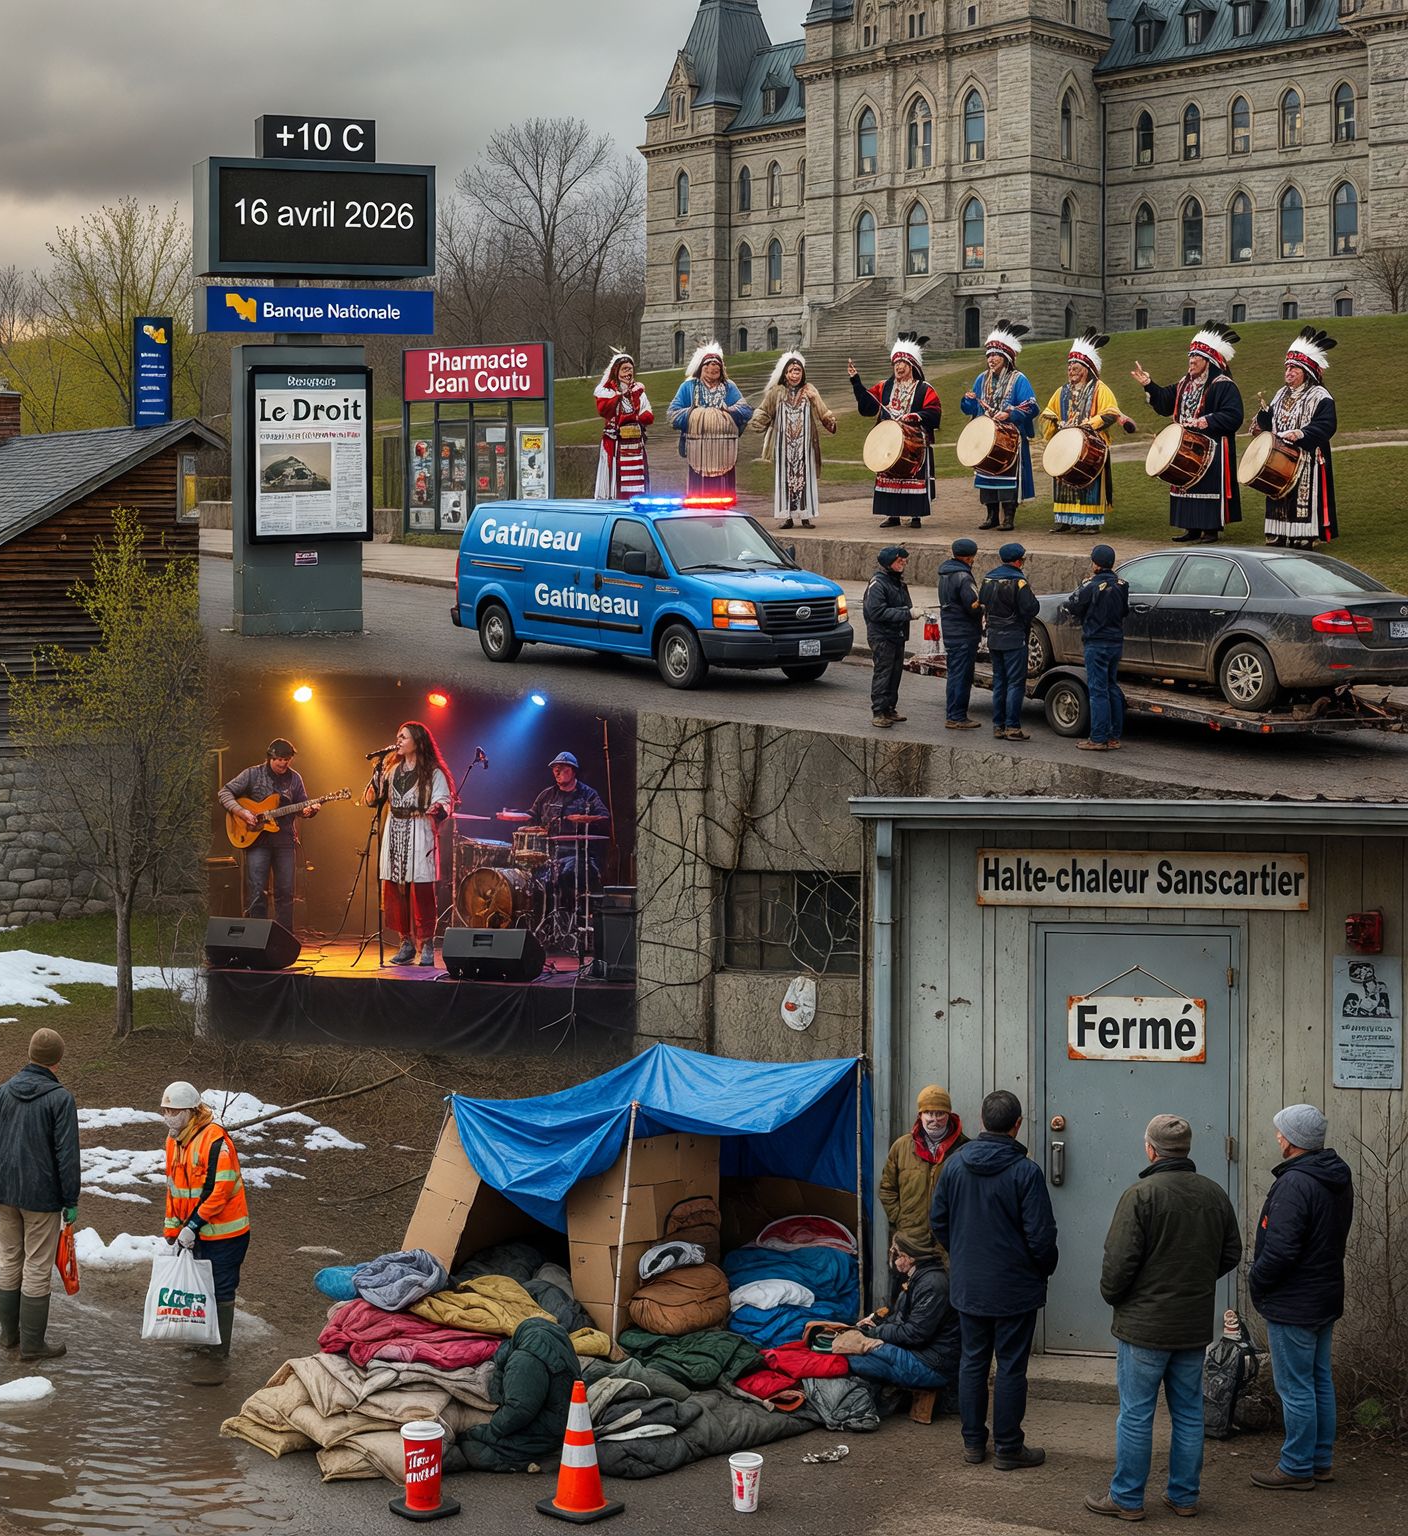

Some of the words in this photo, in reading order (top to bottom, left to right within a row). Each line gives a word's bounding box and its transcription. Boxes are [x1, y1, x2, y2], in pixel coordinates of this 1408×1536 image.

[276, 122, 332, 151] +10
[342, 124, 364, 152] C
[234, 198, 269, 226] 16
[277, 200, 335, 228] avril
[344, 200, 414, 230] 2026
[263, 302, 324, 322] Banque
[327, 303, 401, 320] Nationale
[428, 348, 528, 372] Pharmacie
[424, 373, 469, 394] Jean
[474, 370, 531, 393] Coutu
[259, 398, 289, 422] Le
[292, 397, 362, 421] Droit
[479, 518, 582, 552] Gatineau
[982, 857, 1150, 894] Halte-chaleur
[1156, 859, 1306, 897] Sanscartier
[1076, 1003, 1198, 1052] Fermé
